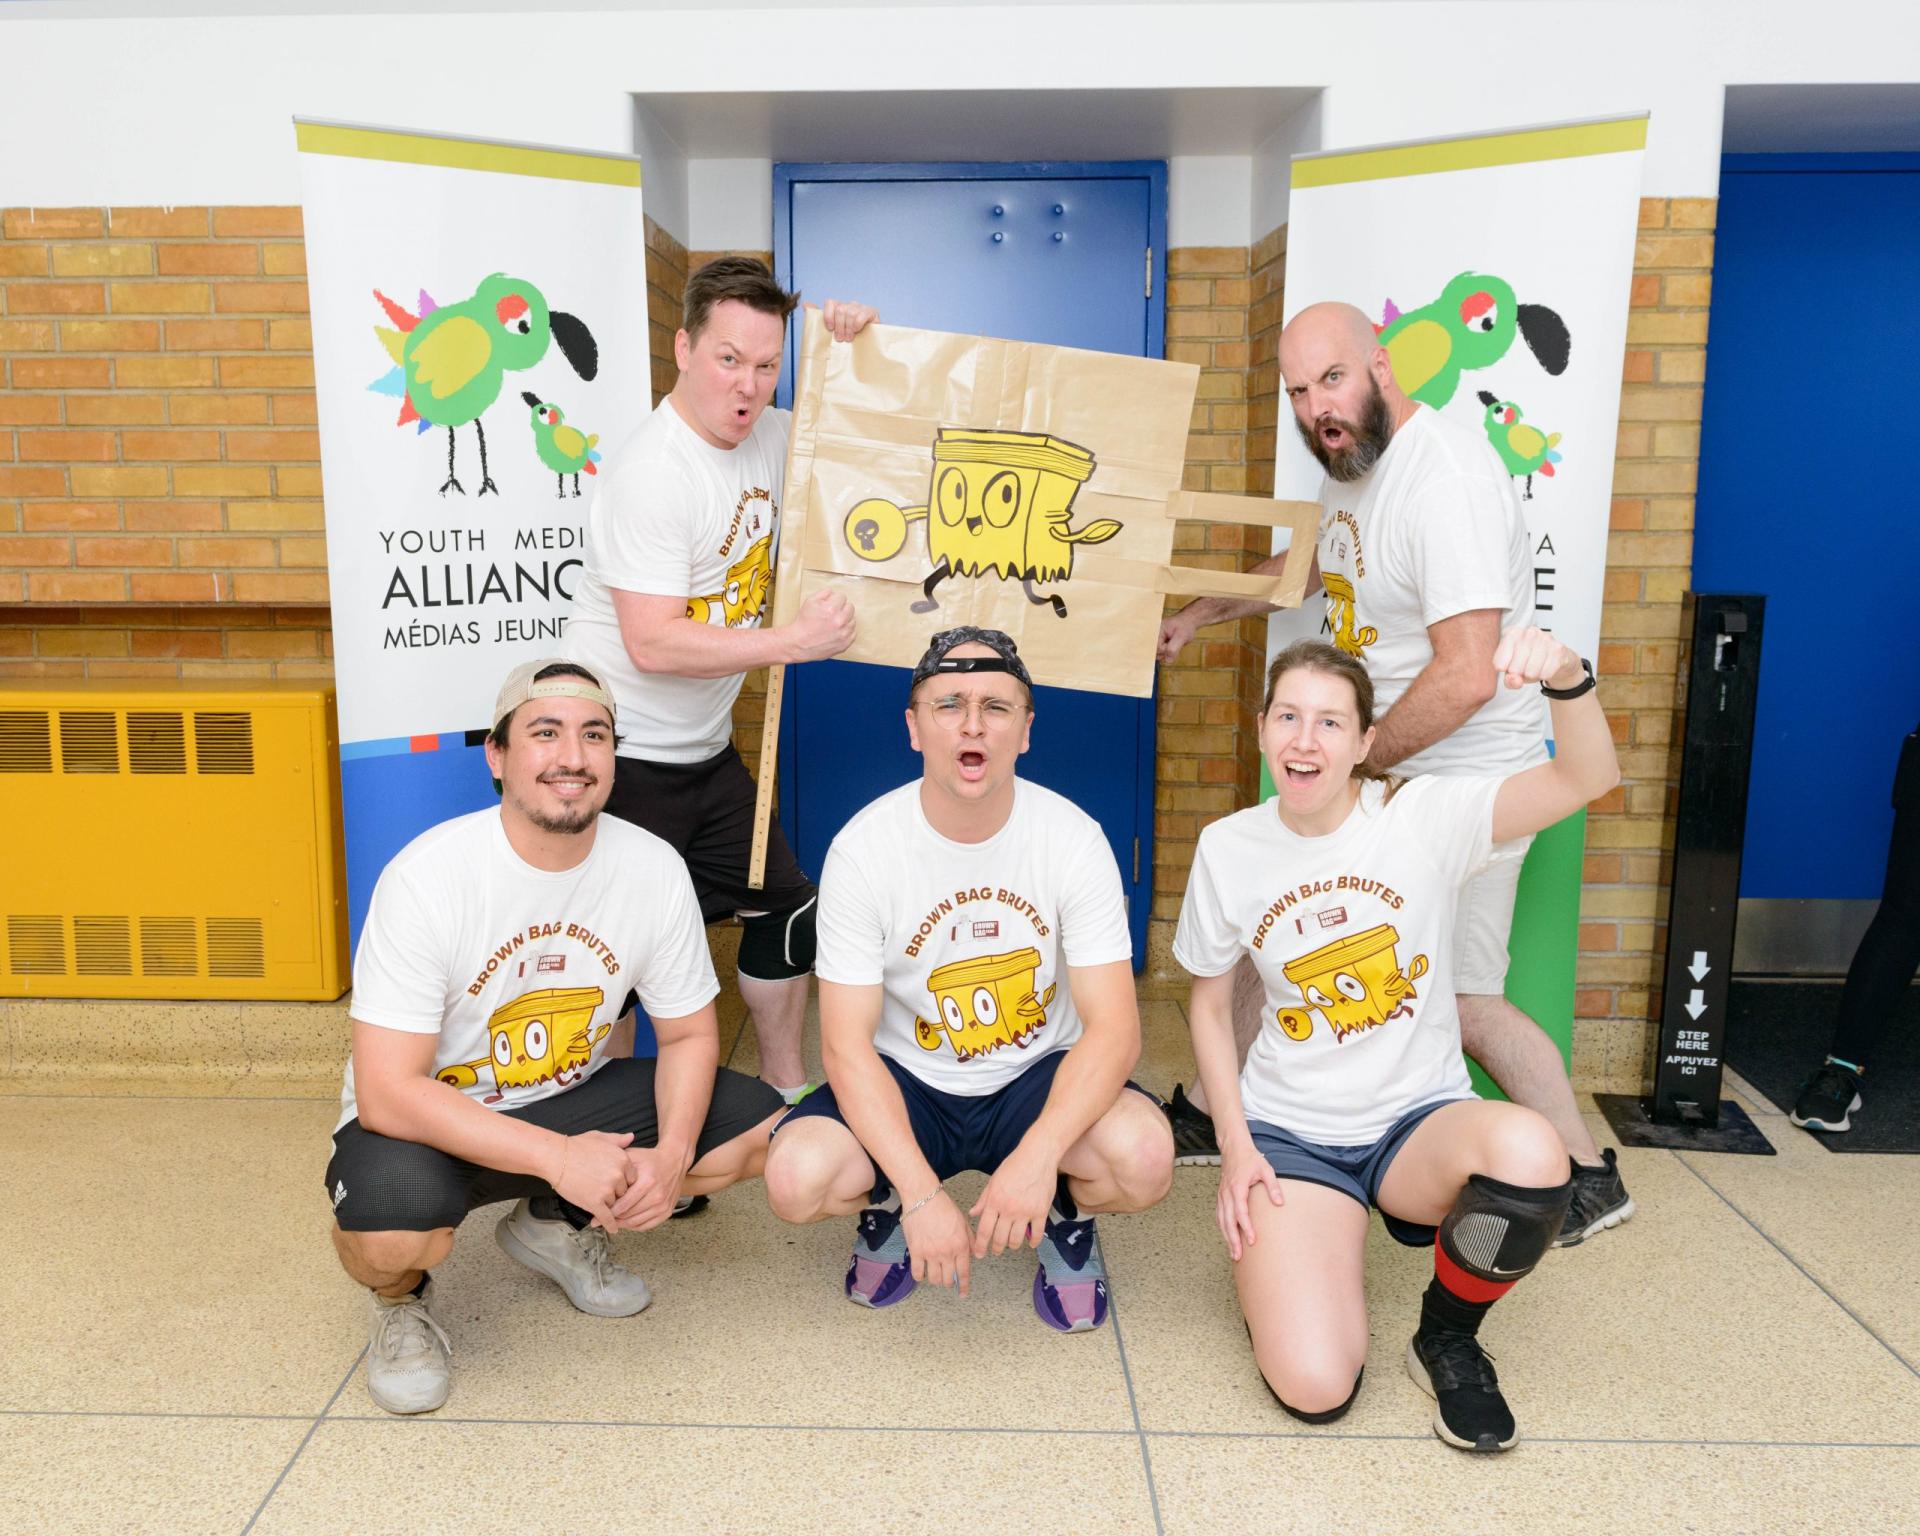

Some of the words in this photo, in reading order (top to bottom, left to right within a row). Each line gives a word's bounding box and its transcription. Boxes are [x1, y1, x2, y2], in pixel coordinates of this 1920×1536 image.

[379, 529, 485, 554] YOUTH
[719, 501, 745, 557] BROWN
[1337, 510, 1353, 526] BAG
[1350, 520, 1366, 578] BRUTES
[384, 618, 481, 650] MÉDIAS
[905, 899, 953, 957] BROWN
[955, 887, 993, 905] BAG
[996, 888, 1050, 937] BRUTES
[1252, 891, 1298, 949] BROWN
[1299, 880, 1333, 899] BAG
[1336, 876, 1404, 910] BRUTES
[467, 933, 525, 996] BROWN
[528, 921, 562, 941] BAG
[566, 922, 621, 976] BRUTES
[1676, 1040, 1709, 1050] HERE
[1677, 1030, 1709, 1040] STEP
[1665, 1055, 1718, 1066] APPUYEZ
[1681, 1066, 1697, 1075] ICI
